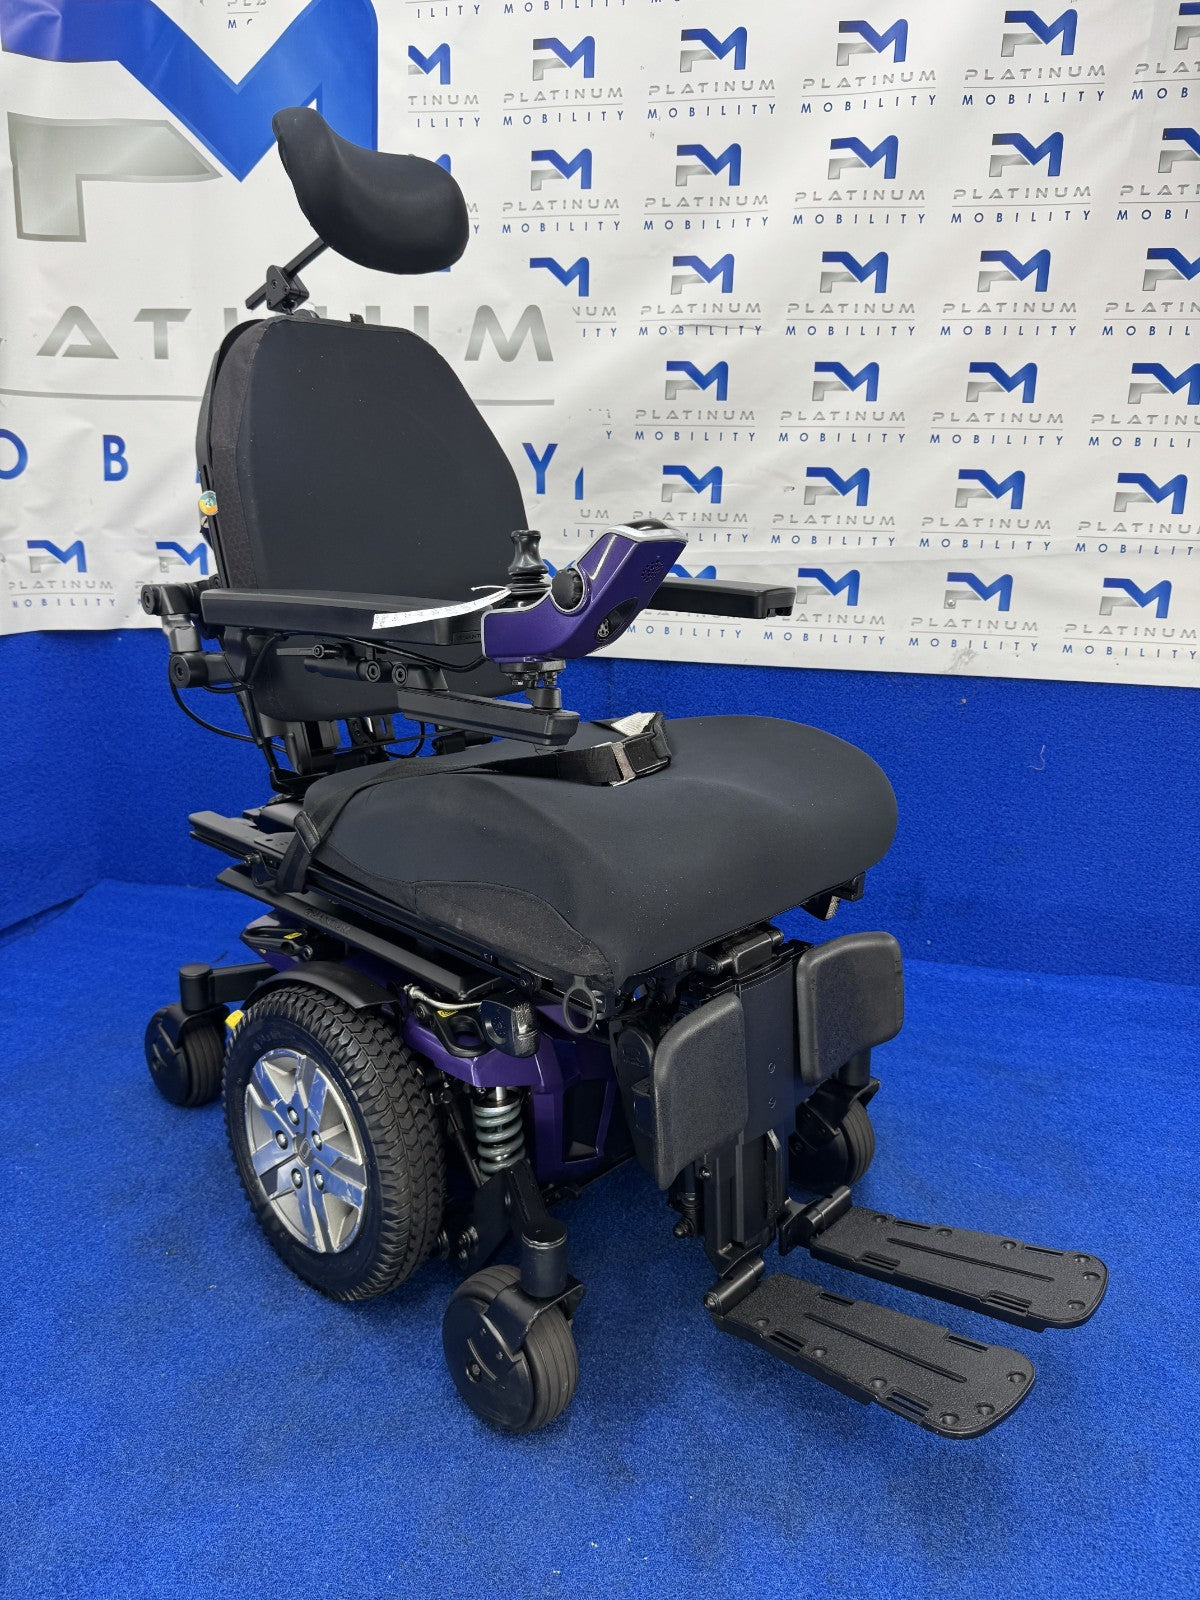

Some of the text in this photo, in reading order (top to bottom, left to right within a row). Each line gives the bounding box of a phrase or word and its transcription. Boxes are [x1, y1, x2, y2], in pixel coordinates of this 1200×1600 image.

[965, 65, 1105, 80] PLATINUM
[803, 70, 936, 89] PLATINUM
[649, 79, 775, 95] PLATINUM
[504, 87, 623, 103] PLATINUM
[962, 91, 1104, 105] MOBILITY
[801, 95, 936, 113] MOBILITY
[648, 104, 775, 119] MOBILITY
[503, 111, 623, 125] MOBILITY
[795, 190, 925, 202] PLATINUM
[953, 186, 1091, 199] PLATINUM
[503, 199, 619, 212] PLATINUM
[645, 195, 768, 207] PLATINUM
[793, 214, 925, 224] MOBILITY
[951, 210, 1090, 223] MOBILITY
[502, 221, 620, 233] MOBILITY
[644, 217, 768, 230] MOBILITY
[641, 303, 761, 315] PLATINUM
[788, 303, 915, 313] PLATINUM
[943, 302, 1076, 313] PLATINUM
[639, 325, 761, 335] MOBILITY
[786, 326, 915, 335] MOBILITY
[940, 326, 1076, 335] MOBILITY
[636, 410, 754, 420] PLATINUM
[780, 411, 905, 421] PLATINUM
[932, 412, 1063, 423] PLATINUM
[635, 431, 755, 441] MOBILITY
[779, 433, 905, 443] MOBILITY
[930, 434, 1063, 445] MOBILITY
[773, 514, 895, 525] PLATINUM
[922, 517, 1051, 529] PLATINUM
[771, 535, 895, 546] MOBILITY
[919, 538, 1051, 550] MOBILITY
[911, 617, 1038, 631] PLATINUM
[1065, 624, 1197, 638] PLATINUM
[763, 632, 885, 645] MOBILITY
[909, 637, 1038, 652] MOBILITY
[1062, 644, 1197, 659] MOBILITY
